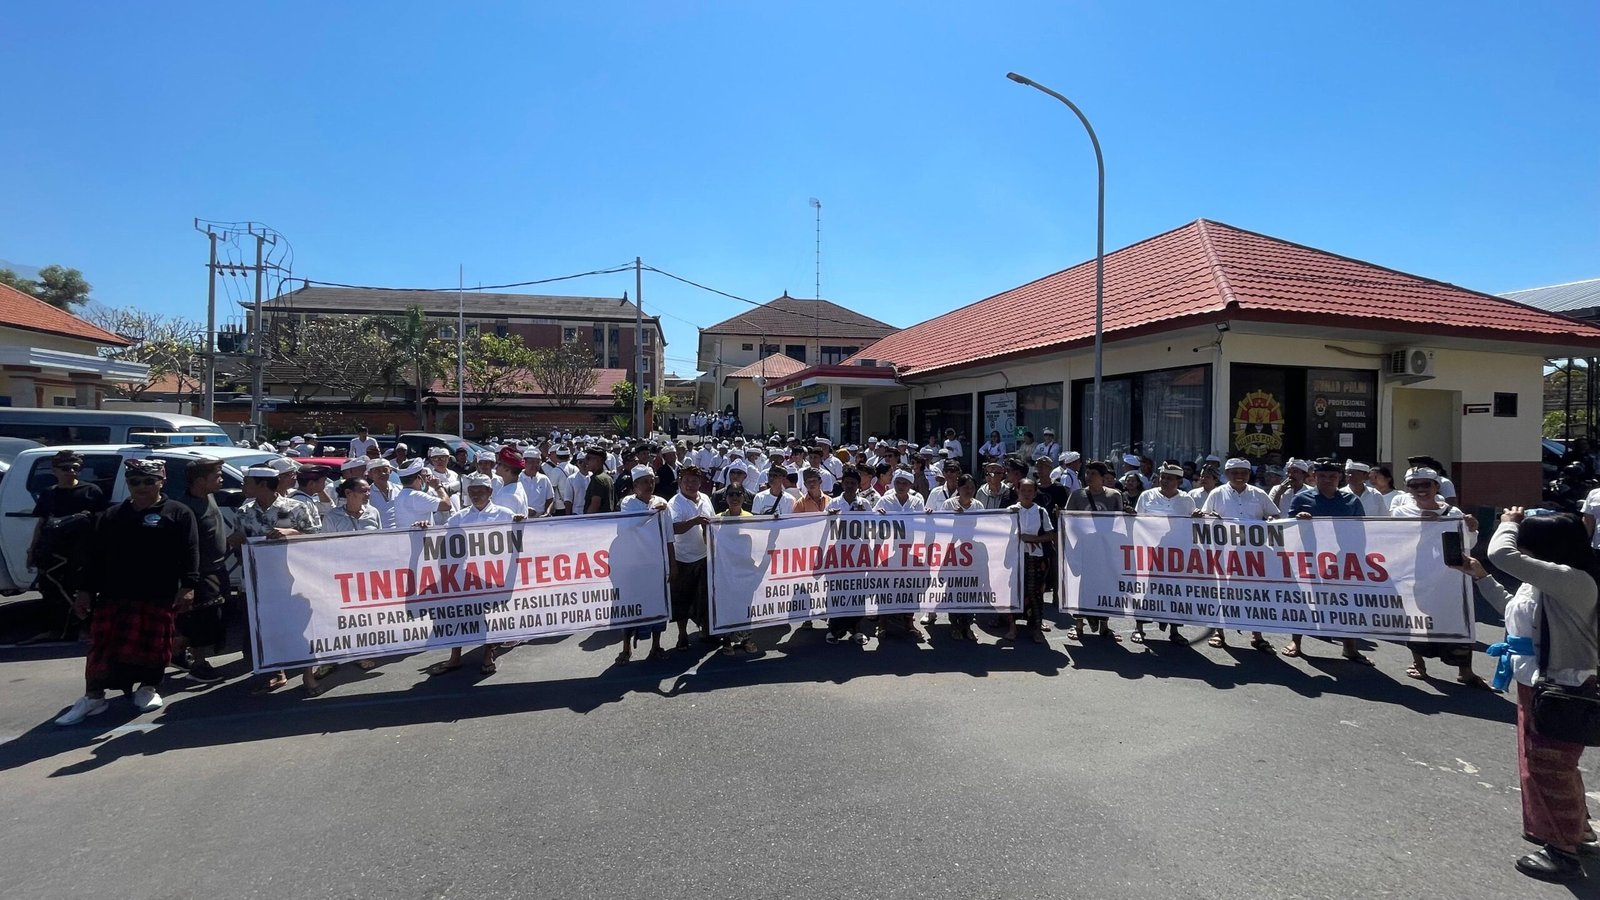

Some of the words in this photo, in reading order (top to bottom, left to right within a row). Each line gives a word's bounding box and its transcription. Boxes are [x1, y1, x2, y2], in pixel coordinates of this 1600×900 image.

[1237, 434, 1260, 448] HUMAS
[423, 530, 523, 561] MOHON
[830, 520, 906, 540] MOHON
[1192, 523, 1284, 547] MOHON
[768, 543, 889, 575] TINDAKAN
[899, 542, 973, 567] TEGAS
[1120, 545, 1266, 577] TINDAKAN
[1276, 551, 1389, 582] TEGAS
[334, 560, 505, 603] TINDAKAN
[516, 550, 611, 585] TEGAS
[765, 584, 790, 598] BAGI
[793, 582, 820, 595] PARA
[823, 577, 890, 593] PENGERUSAK
[893, 576, 944, 589] FASILITAS
[947, 576, 979, 588] UMUM
[338, 613, 372, 629] BAGI
[378, 610, 418, 625] PARA
[419, 601, 510, 622] PENGERUSAK
[514, 592, 577, 612] FASILITAS
[582, 588, 620, 604] UMUM
[746, 604, 774, 619] JALAN
[777, 599, 807, 615] MOBIL
[810, 597, 828, 610] DAN
[831, 594, 866, 607] WC/KM
[869, 592, 893, 606] YANG
[895, 592, 914, 604] ADA
[918, 592, 926, 604] DI
[929, 591, 954, 604] PURA
[956, 591, 997, 604] GUMANG
[1118, 581, 1146, 594] BAGI
[1150, 582, 1182, 597] PARA
[1186, 585, 1271, 603] PENGERUSAK
[1275, 589, 1349, 607] FASILITAS
[1353, 593, 1403, 609] UMUM
[1097, 595, 1128, 609] JALAN
[1132, 598, 1167, 612] MOBIL
[1170, 601, 1193, 615] DAN
[1197, 603, 1240, 617] WC/KM
[1244, 606, 1277, 621] YANG
[1281, 608, 1307, 622] ADA
[1311, 610, 1325, 624] DI
[1330, 611, 1367, 627] PURA
[1372, 613, 1434, 630] GUMANG
[309, 636, 352, 655] JALAN
[356, 631, 398, 648] MOBIL
[403, 627, 429, 642] DAN
[432, 621, 480, 638] WC/KM
[484, 615, 515, 632] YANG
[519, 613, 542, 629] ADA
[546, 611, 557, 626] DI
[561, 608, 591, 624] PURA
[595, 603, 642, 621] GUMANG
